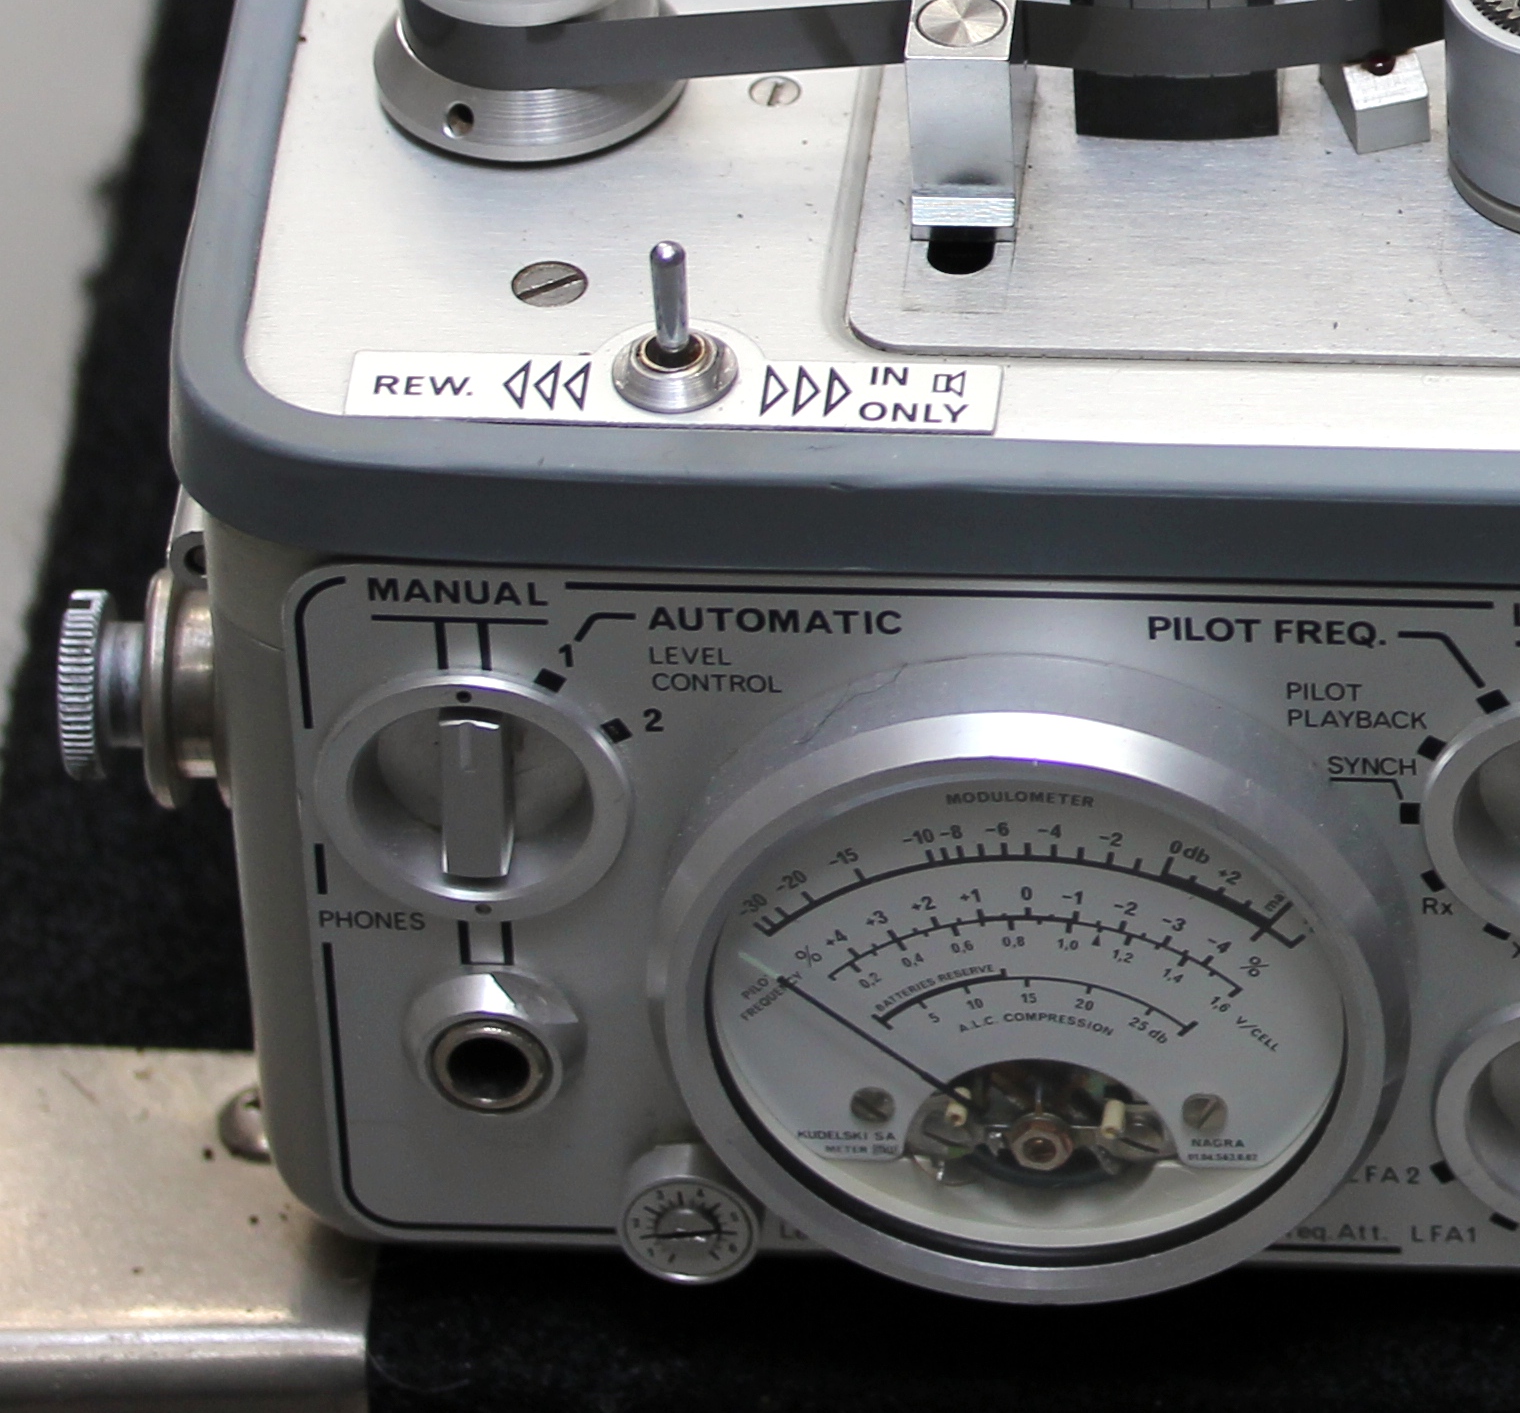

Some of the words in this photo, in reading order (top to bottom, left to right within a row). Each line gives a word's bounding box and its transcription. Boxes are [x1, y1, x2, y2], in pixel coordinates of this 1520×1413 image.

[374, 375, 473, 396] REW.
[869, 367, 907, 386] IN
[859, 401, 968, 424] ONLY
[367, 577, 549, 606] MANUAL
[647, 606, 903, 635] AUTOMATIC
[1147, 616, 1261, 643] PILOT
[1274, 618, 1387, 649] FREQ.
[559, 644, 573, 667] 1
[648, 646, 732, 667] LEVEL
[651, 672, 782, 694] CONTROL
[1286, 682, 1363, 703] PILOT
[643, 708, 663, 732] 2
[1287, 708, 1427, 730] PLAYBACK
[1328, 755, 1418, 777] SYNCH
[946, 790, 1095, 808] MODULOMETER
[902, 828, 935, 845] -10
[940, 824, 963, 839] -8
[985, 822, 1010, 836] -6
[1037, 823, 1062, 838] -4
[1099, 832, 1123, 848] -2
[828, 848, 859, 867] -15
[776, 870, 808, 893] -20
[1218, 868, 1242, 885] +2
[960, 888, 981, 903] +1
[1021, 886, 1033, 901] 0
[1062, 890, 1083, 905] -1
[739, 893, 768, 916] -30
[911, 895, 935, 911] +2
[1114, 901, 1138, 917] -2
[1422, 898, 1454, 917] Rx
[318, 909, 426, 931] PHONES
[865, 910, 889, 927] +3
[1162, 917, 1187, 932] -3
[826, 929, 848, 947] +4
[951, 940, 974, 954] 0,6
[1003, 936, 1026, 948] 0,8
[1057, 938, 1079, 951] 1,0
[1207, 937, 1232, 954] -4
[794, 945, 822, 967] %
[1112, 949, 1134, 964] 1,2
[1240, 956, 1269, 977] %
[875, 977, 935, 1013] BATTERIES
[937, 963, 993, 983] RESERVE
[966, 997, 985, 1011] 10
[1021, 992, 1038, 1004] 15
[1074, 998, 1095, 1012] 20
[928, 1012, 941, 1024] 5
[1003, 1012, 1115, 1037] COMPRESSION
[797, 1130, 868, 1140] KUDELSKI
[874, 1131, 896, 1141] SA
[1191, 1138, 1245, 1148] NAGRA
[1411, 1225, 1476, 1243] LFA1
